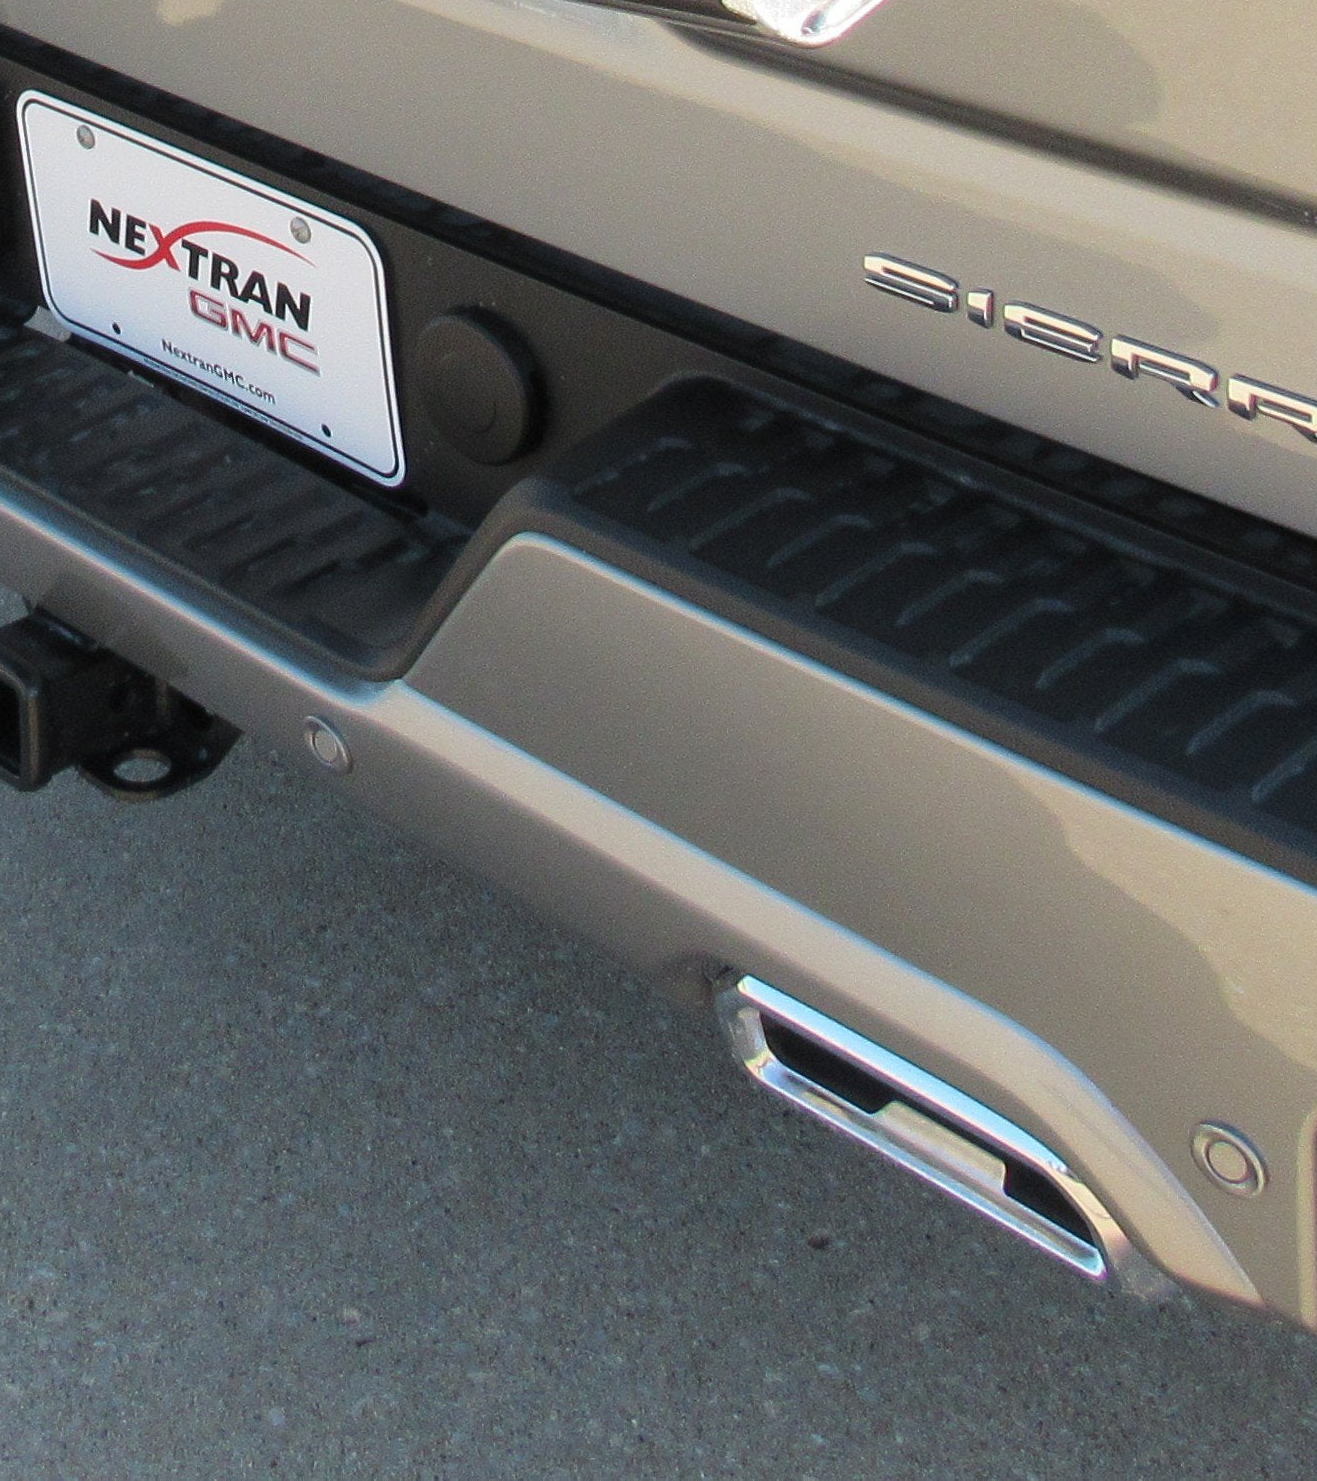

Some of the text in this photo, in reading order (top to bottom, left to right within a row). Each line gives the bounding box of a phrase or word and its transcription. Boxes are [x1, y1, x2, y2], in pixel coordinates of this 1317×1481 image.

[89, 198, 312, 332] NEXTRAN
[161, 338, 276, 405] NextranGMC.com
[188, 287, 321, 377] GMC
